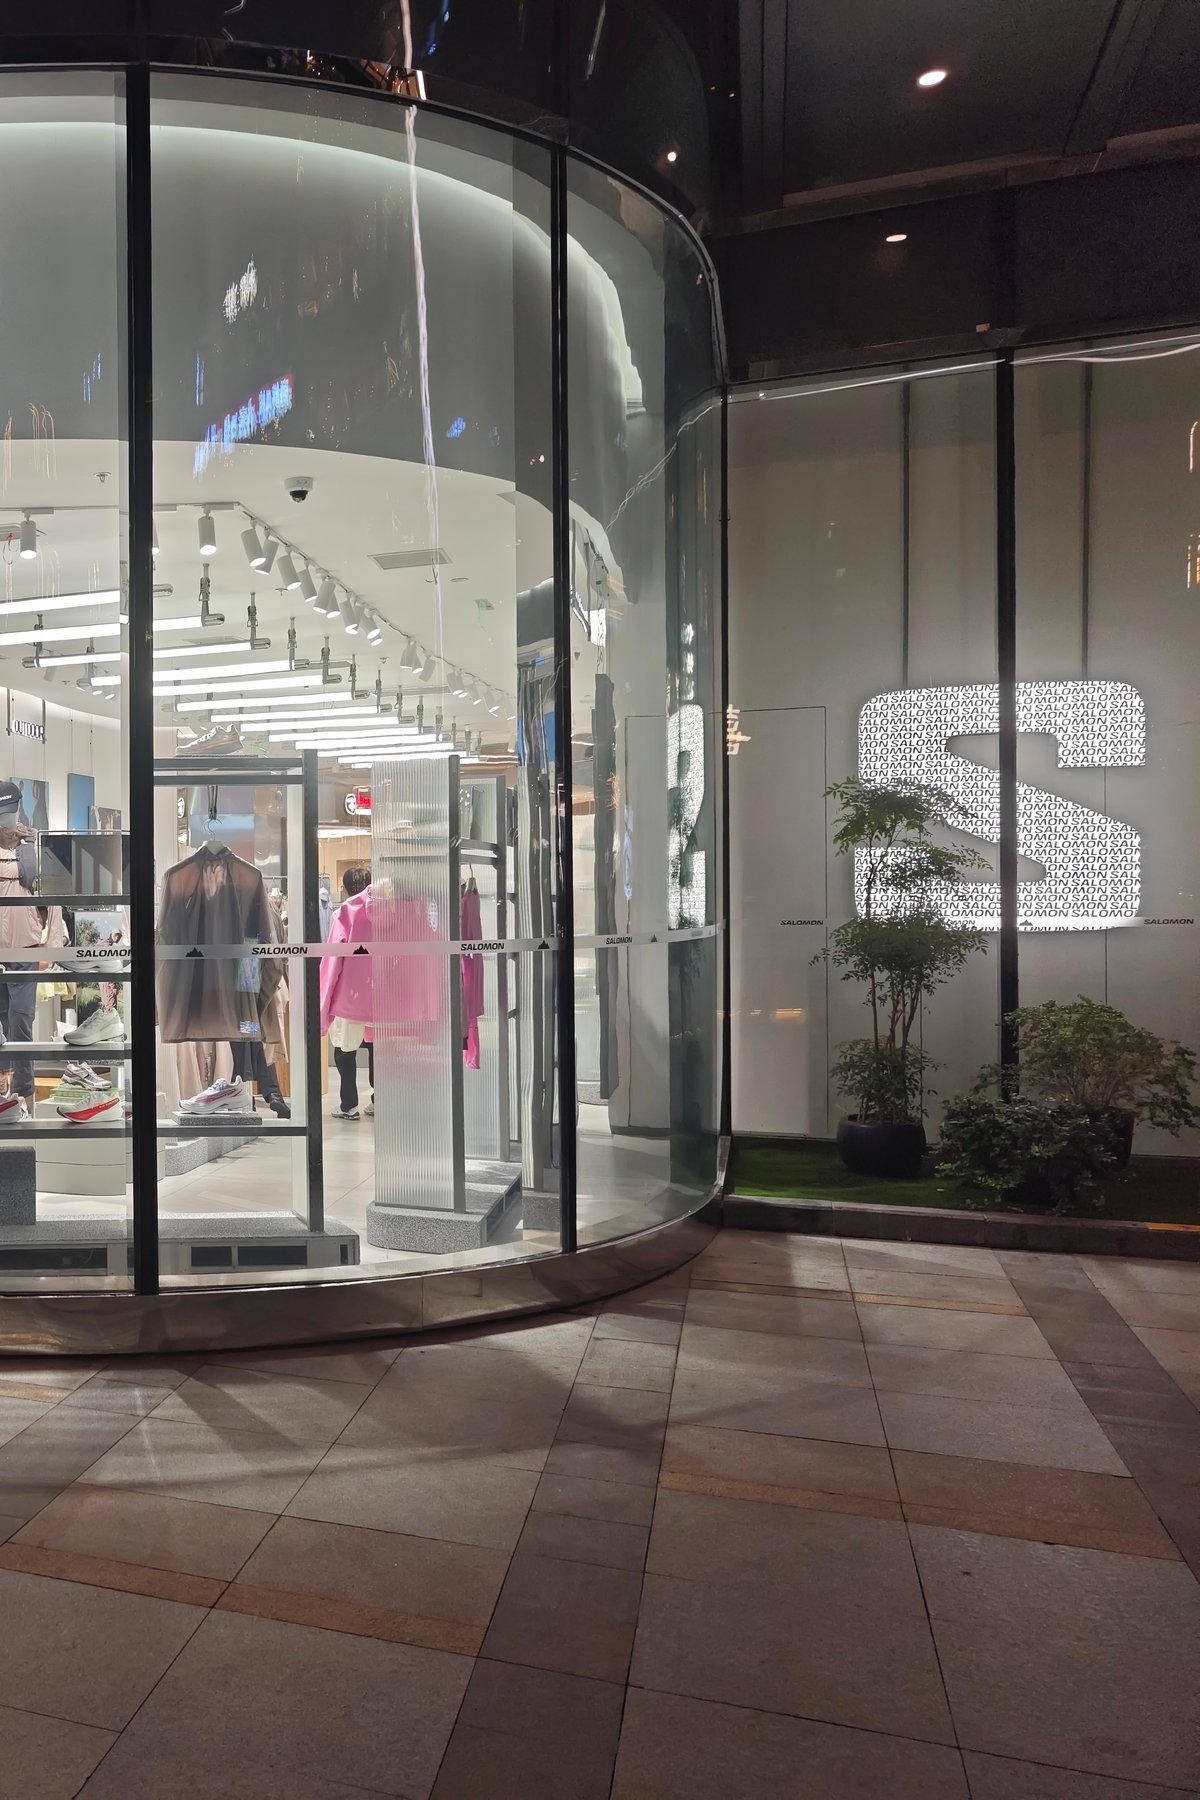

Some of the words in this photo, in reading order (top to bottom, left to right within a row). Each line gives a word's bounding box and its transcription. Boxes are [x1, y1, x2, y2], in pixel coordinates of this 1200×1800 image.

[1035, 686, 1106, 696] SALOMON
[891, 693, 959, 703] SALOMON
[864, 702, 922, 712] ALOMON
[925, 699, 996, 708] SALOMON
[1035, 702, 1106, 711] SALOMON
[891, 708, 959, 718] SALOMON
[925, 714, 996, 723] SALOMON
[1035, 718, 1106, 726] SALOMON
[891, 723, 959, 732] SALOMON
[891, 768, 959, 776] SALOMON
[925, 774, 996, 783] SALOMON
[1035, 825, 1107, 833] SALOMON
[605, 936, 633, 945] SALOMON
[251, 946, 308, 955] SALOMON
[460, 942, 505, 952] SALOMON
